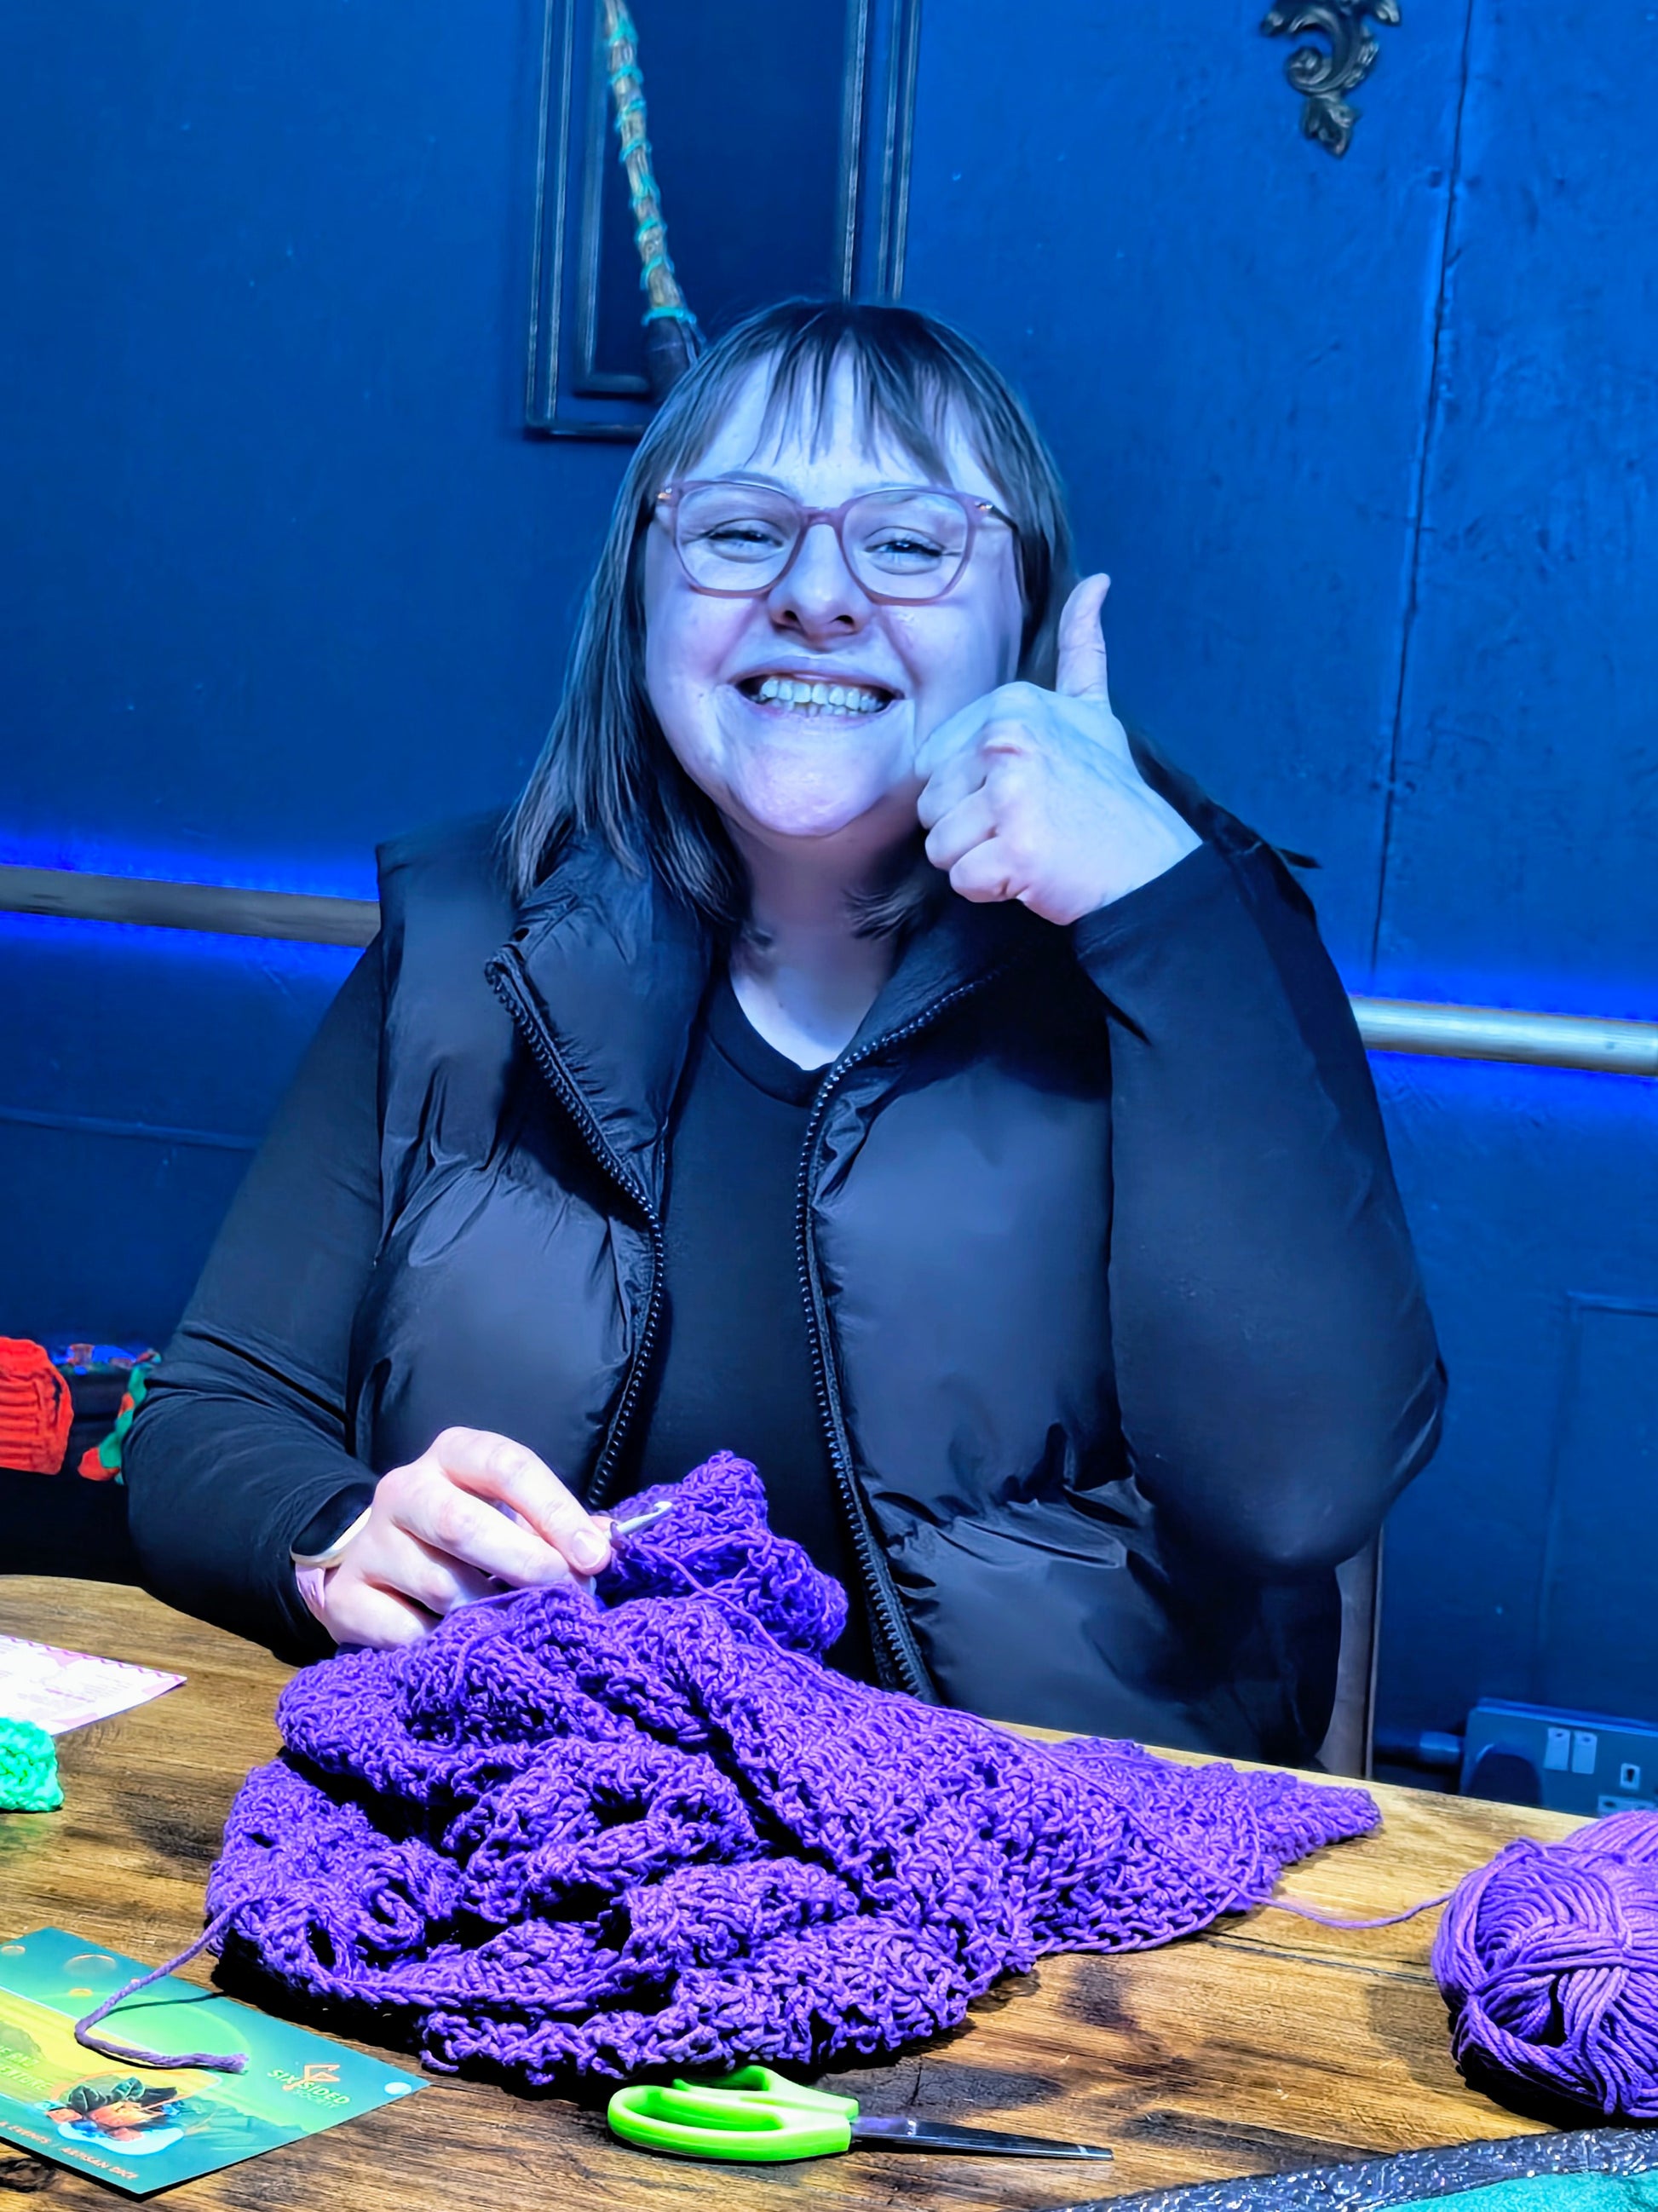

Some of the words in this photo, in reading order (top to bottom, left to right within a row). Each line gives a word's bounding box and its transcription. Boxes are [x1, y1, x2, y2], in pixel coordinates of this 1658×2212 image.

[0, 2062, 55, 2091] ENTURE
[267, 2069, 301, 2084] SIX
[298, 2081, 351, 2105] SIDED
